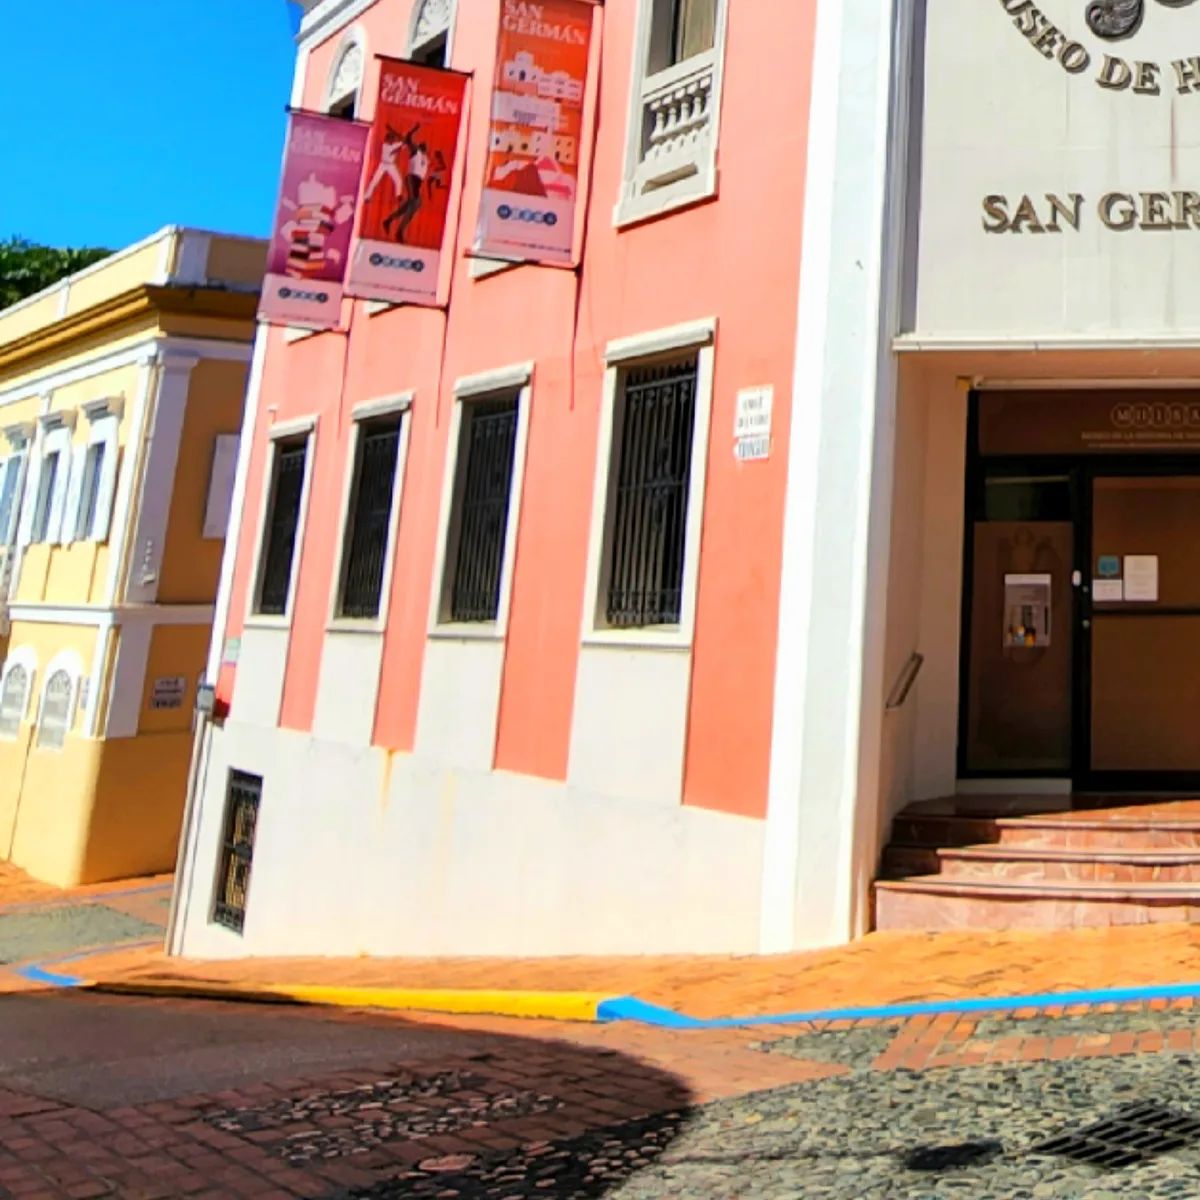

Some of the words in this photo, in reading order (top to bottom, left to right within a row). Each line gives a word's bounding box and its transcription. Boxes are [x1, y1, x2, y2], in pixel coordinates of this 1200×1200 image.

[384, 73, 420, 94] SAN
[1096, 52, 1161, 96] DE
[981, 193, 1085, 234] SAN
